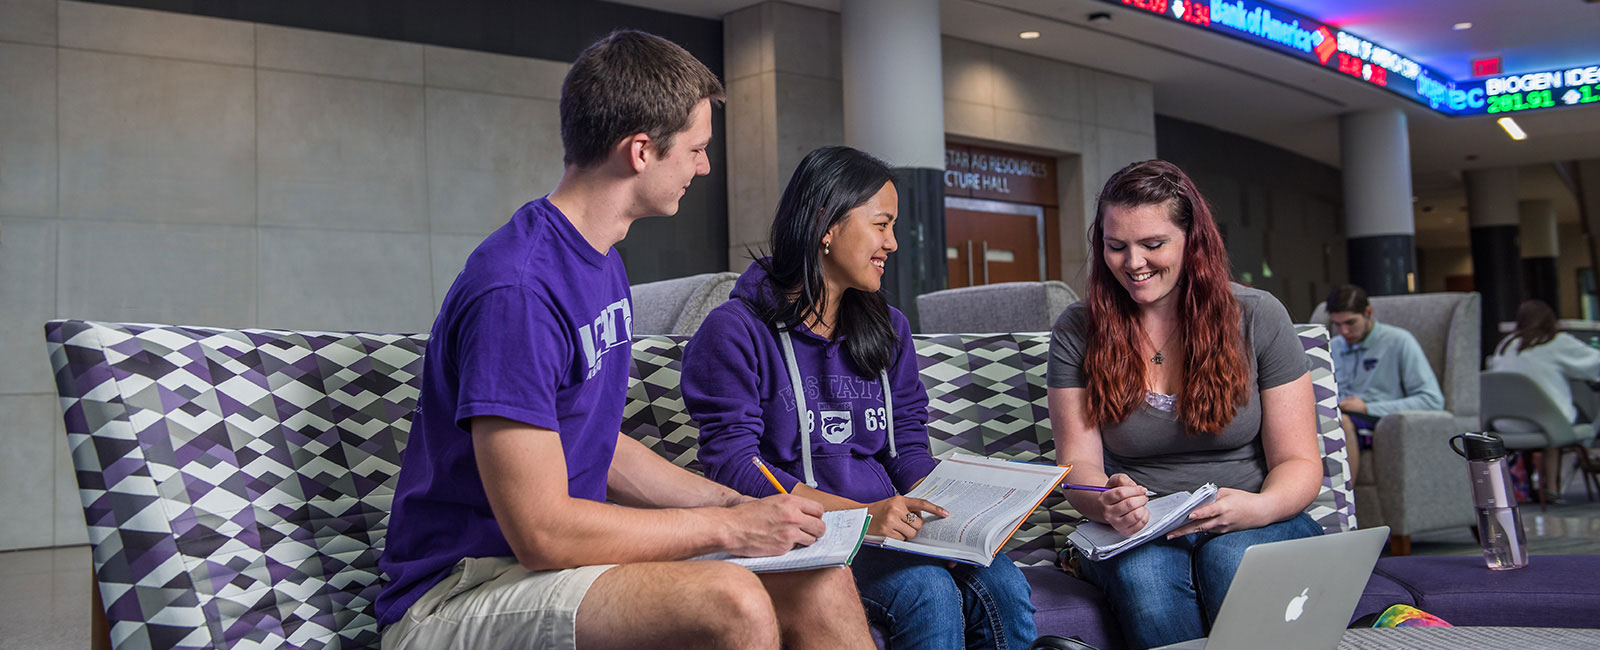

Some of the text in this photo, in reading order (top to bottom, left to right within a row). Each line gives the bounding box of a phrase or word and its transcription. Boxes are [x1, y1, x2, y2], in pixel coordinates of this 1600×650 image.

[1210, 0, 1313, 53] Bank of America
[1485, 71, 1563, 97] BIOGEN
[1487, 83, 1600, 114] 201.91 1.
[971, 152, 987, 171] AG
[989, 155, 1048, 178] RESOURCES
[982, 174, 1010, 193] HALL
[864, 407, 887, 432] 63
